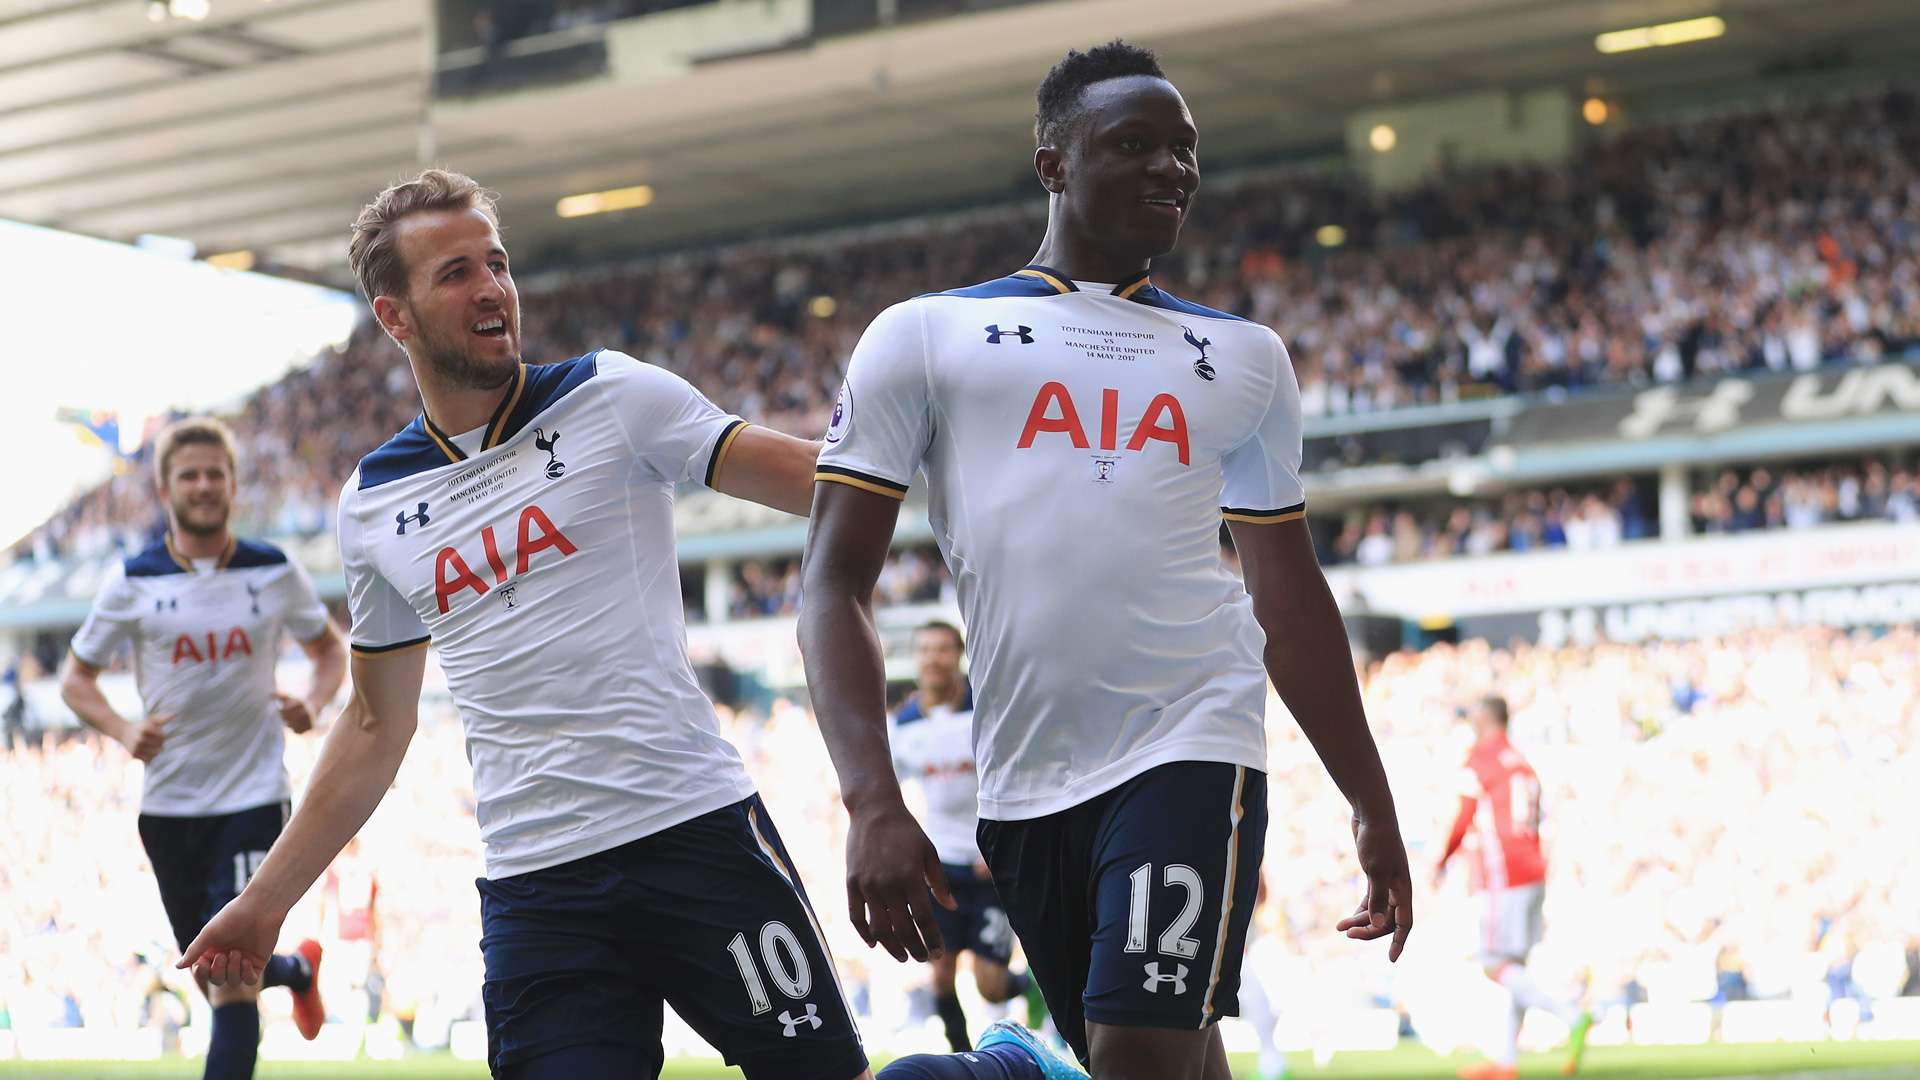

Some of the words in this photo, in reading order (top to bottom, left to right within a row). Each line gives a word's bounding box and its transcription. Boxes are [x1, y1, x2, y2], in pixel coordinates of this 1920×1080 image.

[1061, 326, 1112, 337] TOTTENHAM
[1115, 331, 1155, 340] HOTSPUR
[1065, 341, 1121, 353] MANCHESTER
[1124, 347, 1155, 355] UNITED
[1096, 352, 1115, 360] MAY
[1118, 354, 1136, 362] 2017
[1016, 381, 1190, 466] AIA
[449, 479, 494, 502] MANCHESTER
[493, 466, 518, 483] UNITED
[475, 490, 489, 501] MAY
[435, 505, 578, 615] AIA
[171, 626, 252, 665] AIA
[1124, 863, 1204, 960] 12
[727, 920, 812, 1017] 10
